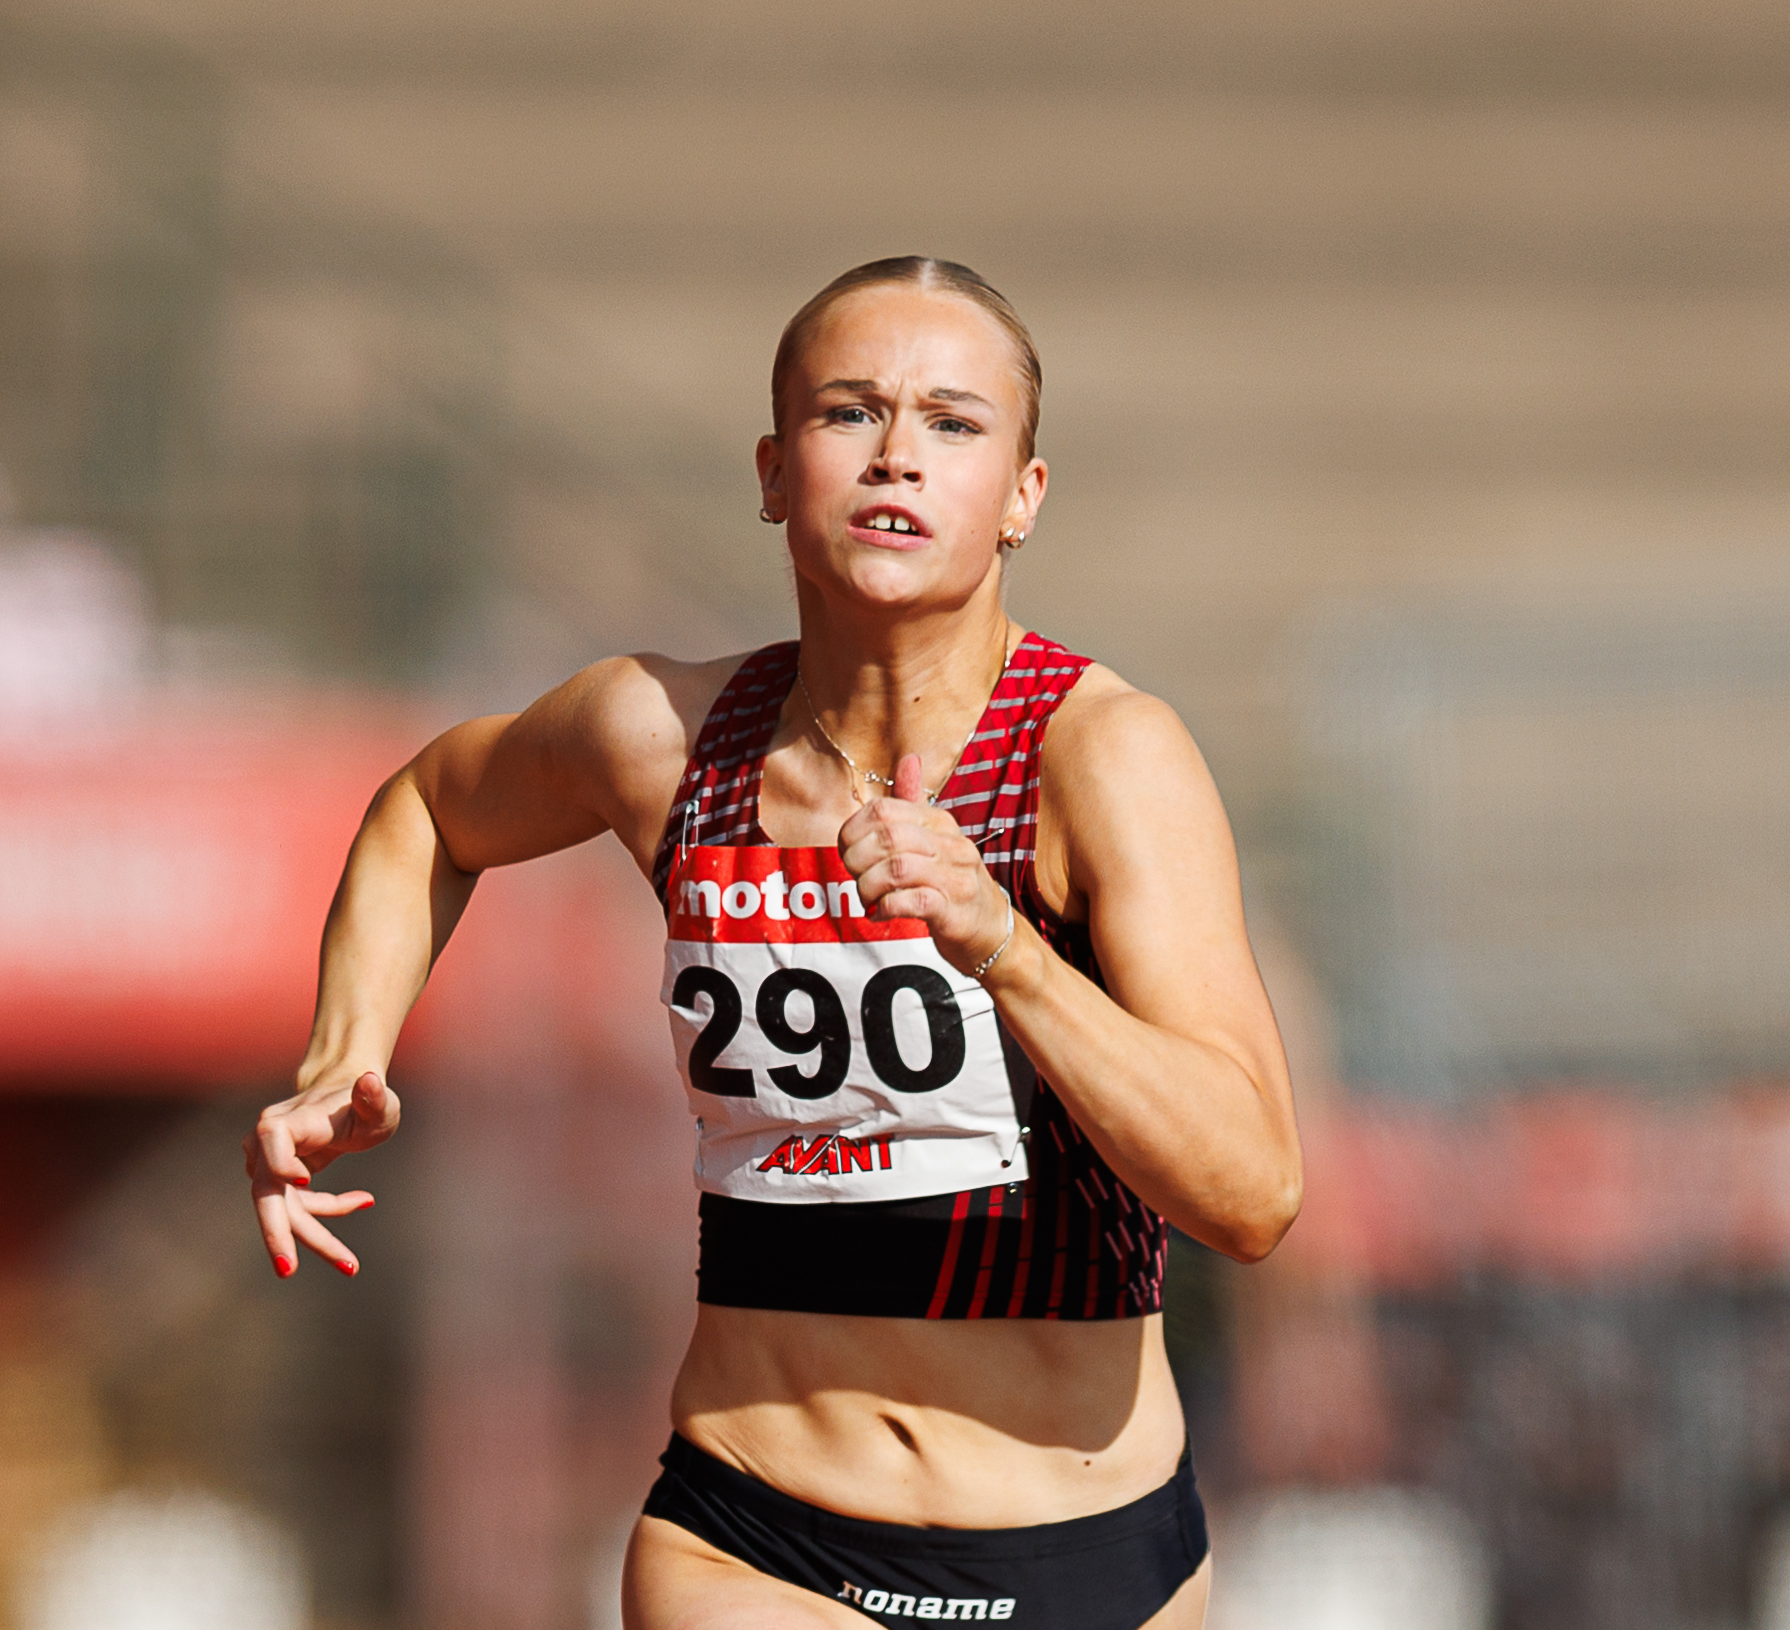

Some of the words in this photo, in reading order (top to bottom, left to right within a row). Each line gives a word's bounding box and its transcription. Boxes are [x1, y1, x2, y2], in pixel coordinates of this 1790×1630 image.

[677, 870, 866, 921] moton
[672, 964, 966, 1100] 290
[756, 1134, 894, 1176] AVANT
[838, 1581, 1016, 1620] noname
